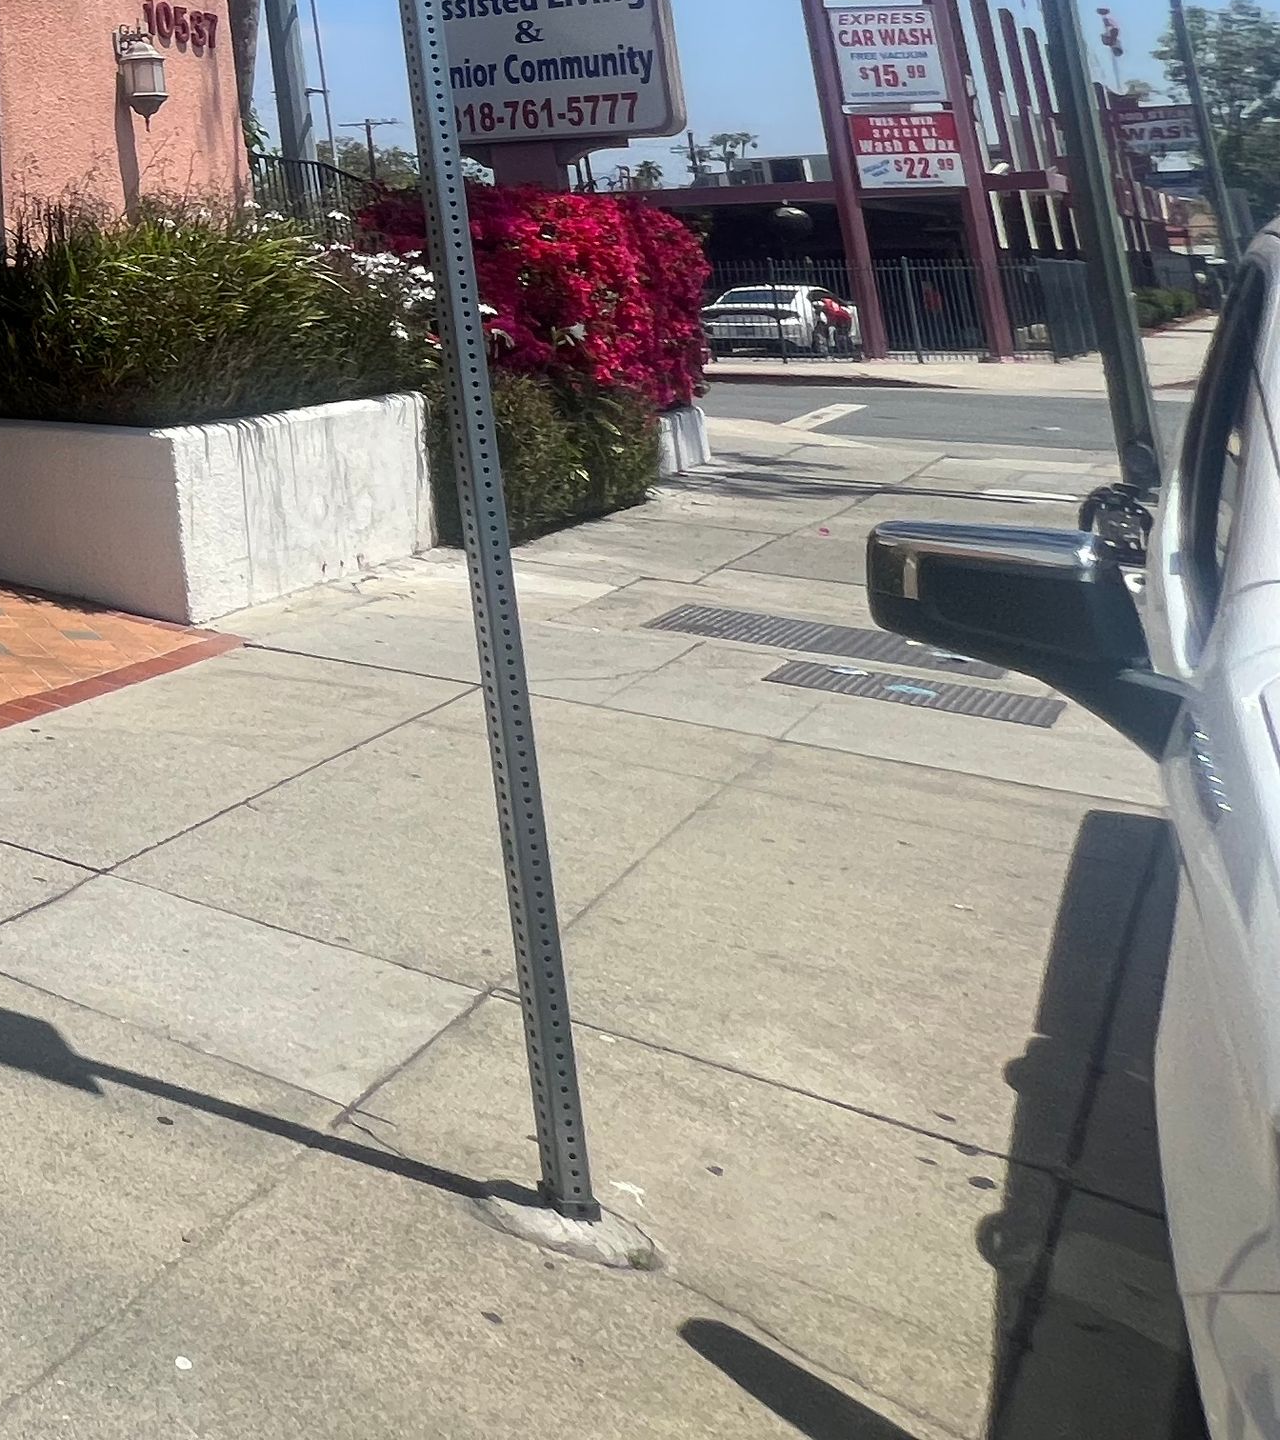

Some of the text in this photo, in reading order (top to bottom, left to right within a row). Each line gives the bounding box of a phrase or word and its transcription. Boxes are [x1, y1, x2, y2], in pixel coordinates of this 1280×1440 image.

[838, 12, 926, 26] EXPRESS
[514, 19, 545, 44] &
[838, 27, 933, 47] CAR WASH
[850, 51, 877, 60] FREE
[449, 44, 654, 89] nior Community
[858, 64, 926, 88] $15.99
[872, 127, 938, 138] SPECIAL
[858, 138, 956, 153] Wash & Wax
[893, 156, 955, 179] $22.99
